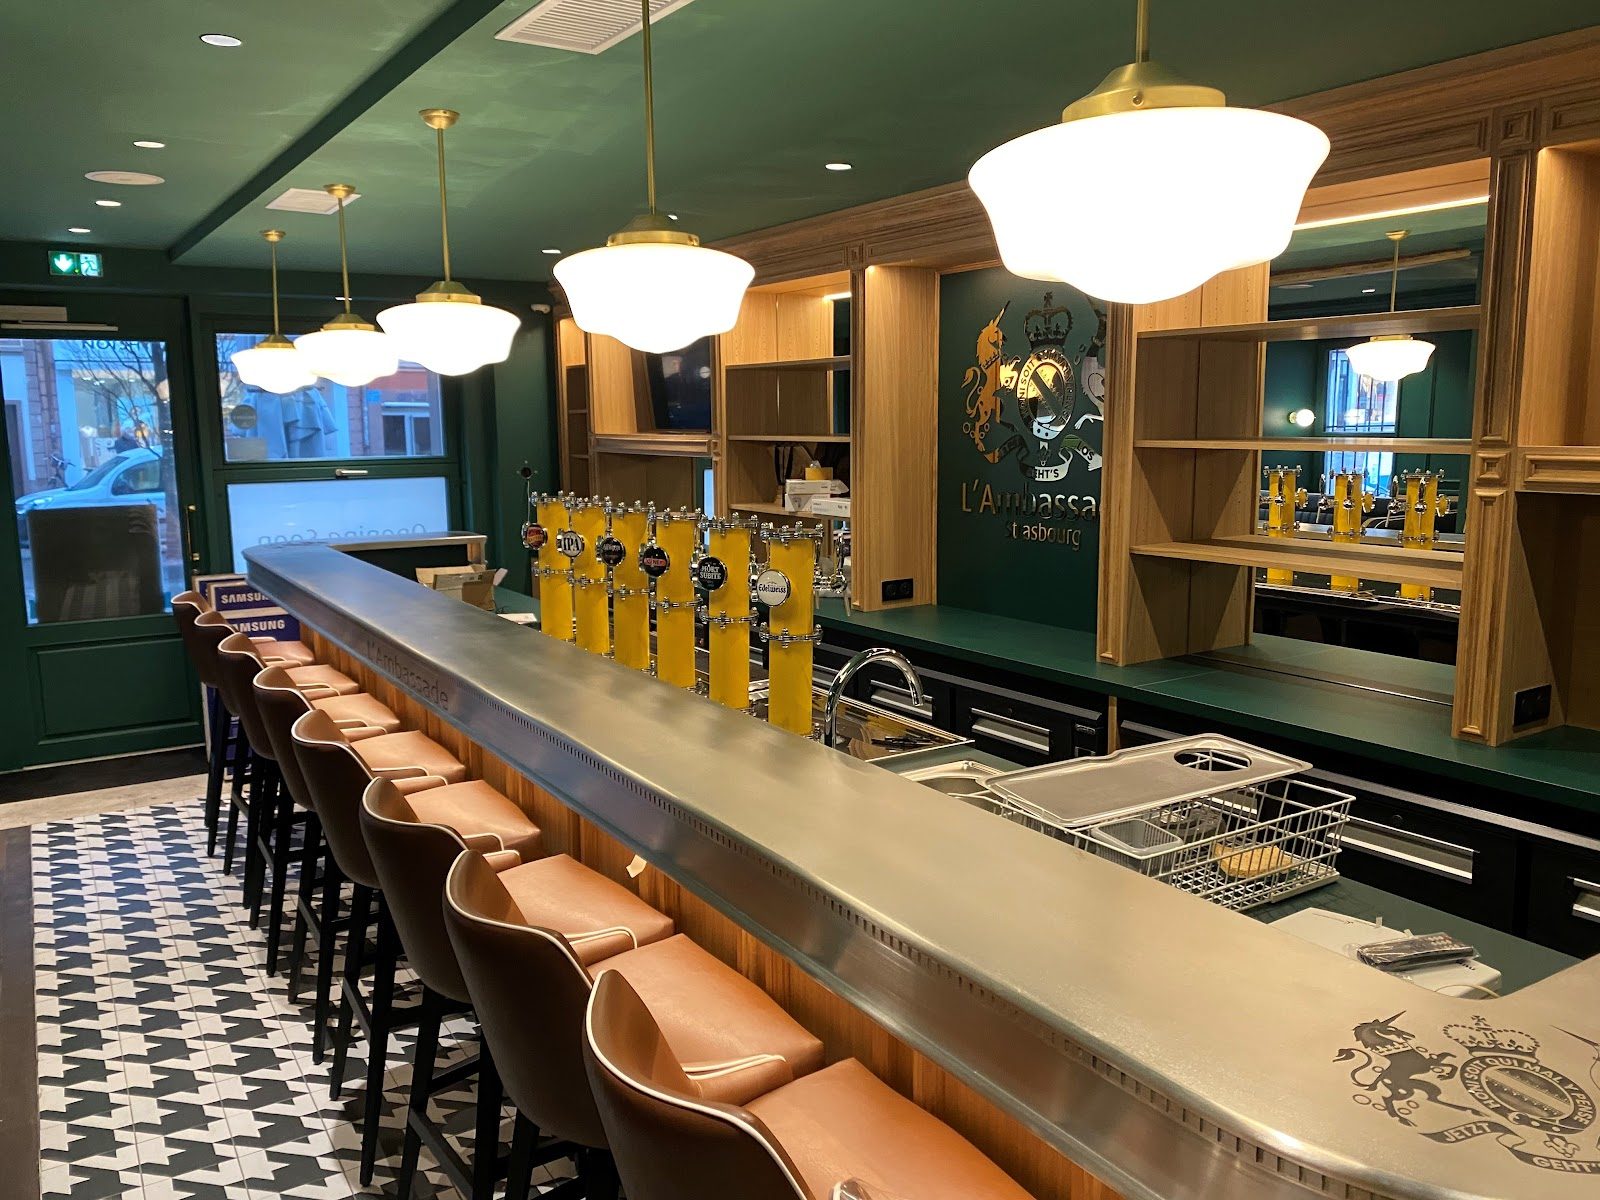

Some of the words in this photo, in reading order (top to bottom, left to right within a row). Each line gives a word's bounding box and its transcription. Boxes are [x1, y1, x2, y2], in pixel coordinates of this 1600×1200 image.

[1021, 359, 1035, 385] SOIT
[1077, 441, 1095, 460] LOS
[961, 479, 1100, 520] L'Ambassa
[563, 538, 580, 551] IPA
[700, 572, 721, 580] SUBITE
[758, 583, 787, 594] Edelweiss
[220, 592, 271, 604] SAMSU
[232, 619, 286, 633] AMSUNG
[1464, 1060, 1487, 1080] SOIT
[1485, 1057, 1519, 1067] QUI
[1523, 1063, 1563, 1083] MAL
[1466, 1080, 1501, 1109] HONI
[1565, 1083, 1579, 1092] Y
[1571, 1091, 1594, 1125] PENSE
[1444, 1122, 1491, 1142] JETZT
[1532, 1156, 1600, 1173] GEHT'
